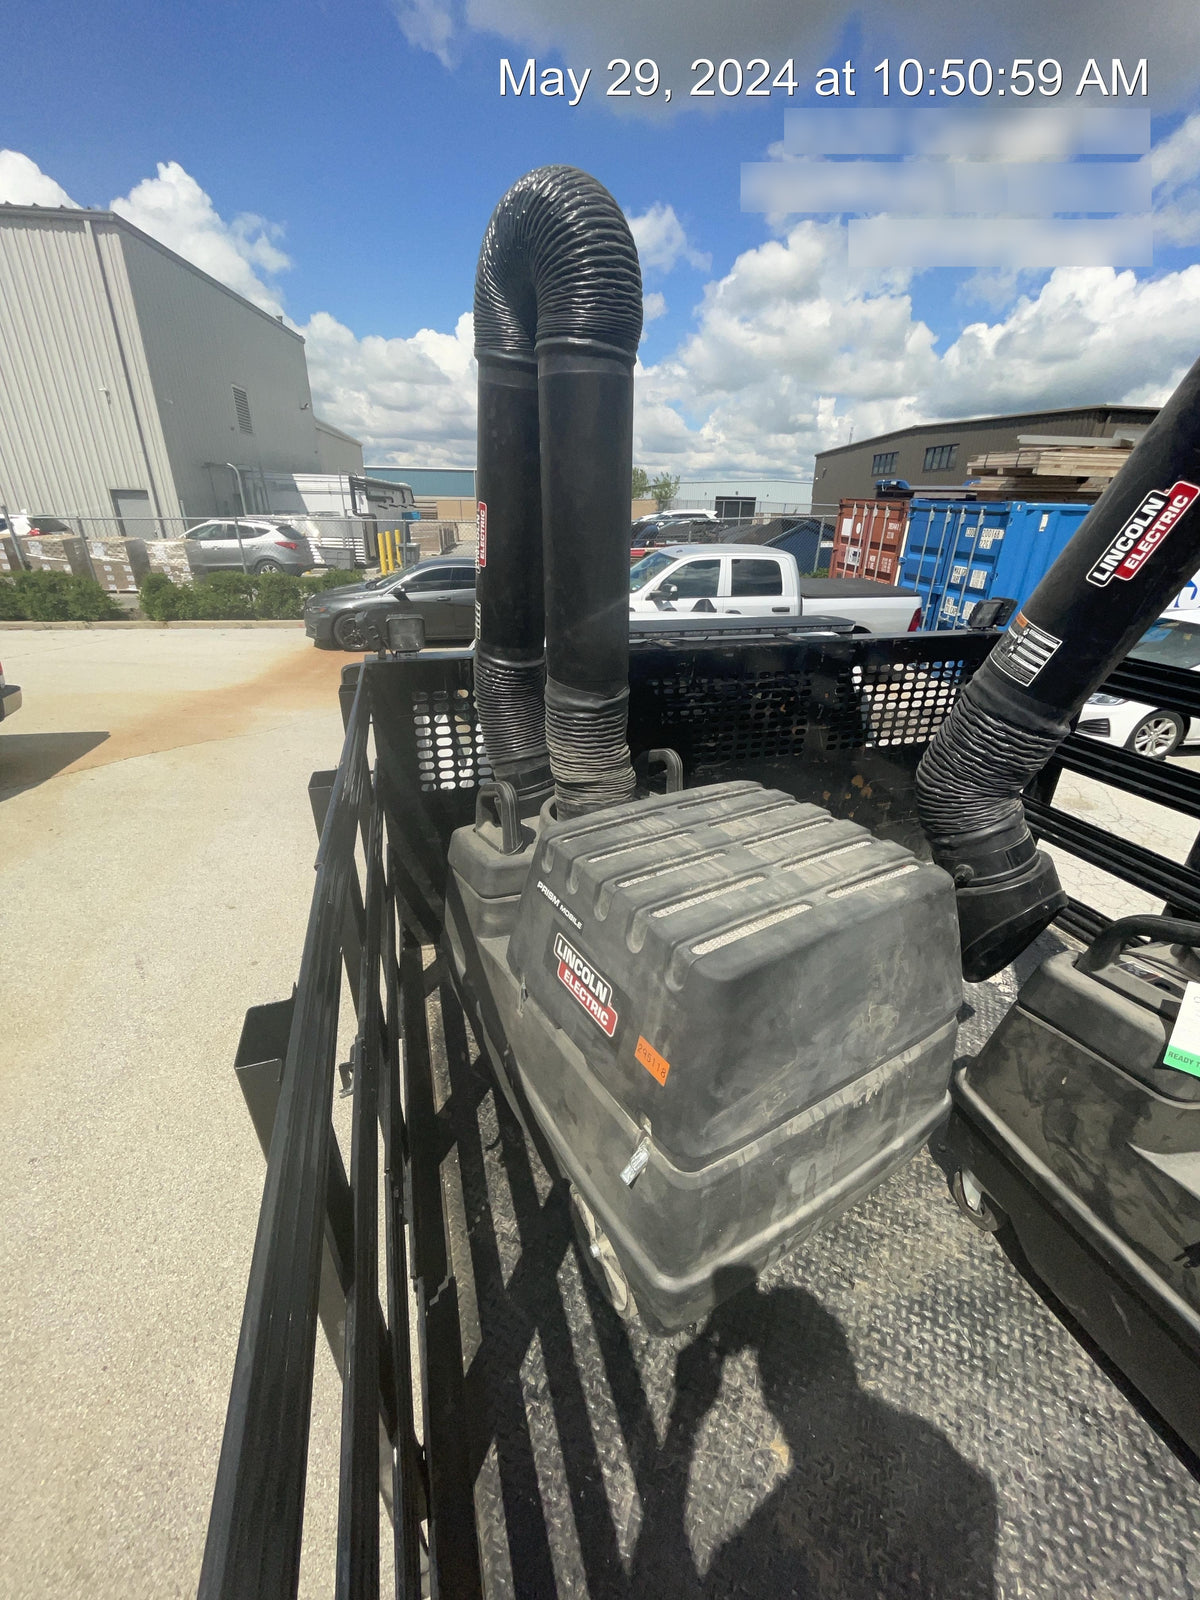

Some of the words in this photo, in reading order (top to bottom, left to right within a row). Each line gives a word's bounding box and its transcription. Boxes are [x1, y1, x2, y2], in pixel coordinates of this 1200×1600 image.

[1092, 497, 1165, 581] LINCOLN
[1124, 495, 1189, 570] ELECTRIC
[537, 880, 560, 907] PRISM
[560, 904, 582, 929] MOBILE
[557, 939, 607, 1003] LINCOLN
[563, 969, 609, 1026] ELECTRIC
[1168, 1050, 1194, 1066] READY
